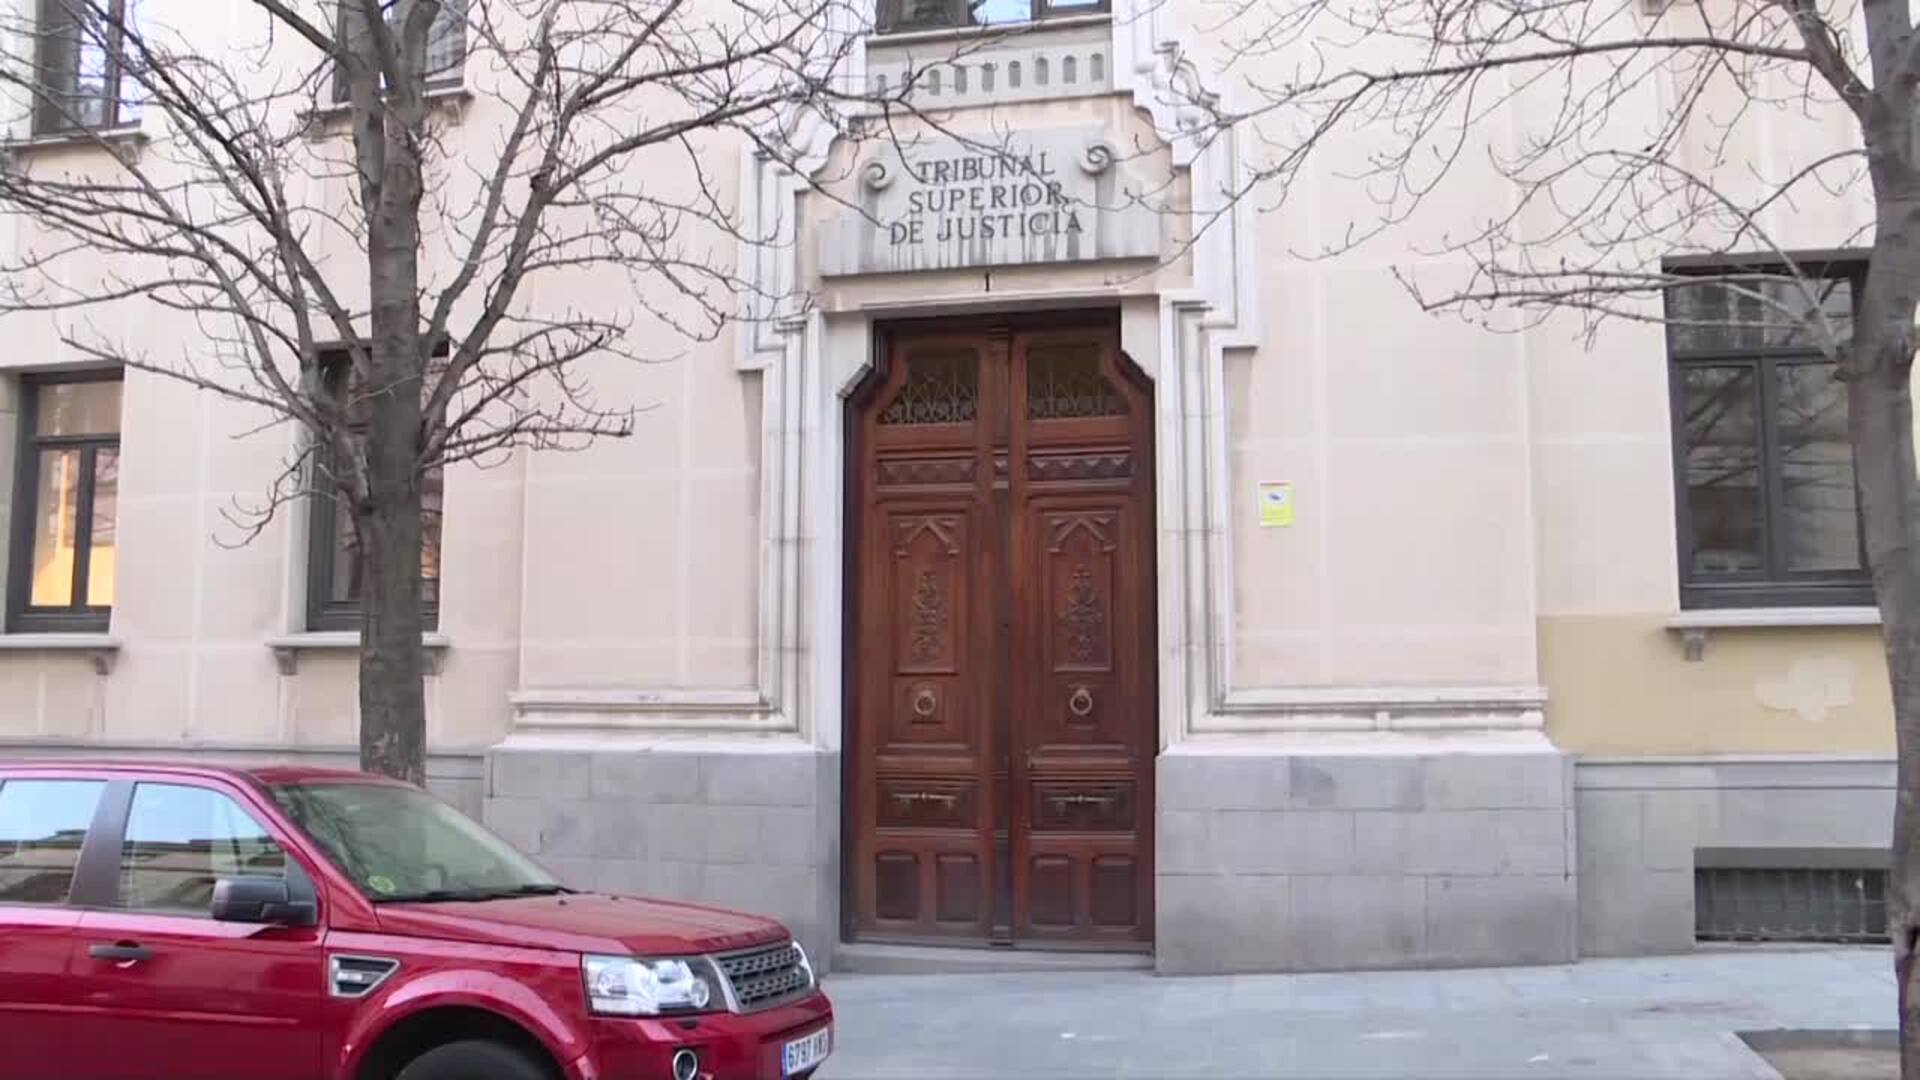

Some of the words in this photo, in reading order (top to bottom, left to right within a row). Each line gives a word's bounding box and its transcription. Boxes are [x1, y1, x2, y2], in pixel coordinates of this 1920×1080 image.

[916, 153, 1055, 183] TRIBUNAL
[909, 182, 1066, 214] SUPERIOR
[890, 221, 924, 245] DE
[937, 211, 1083, 241] JUSTICIA
